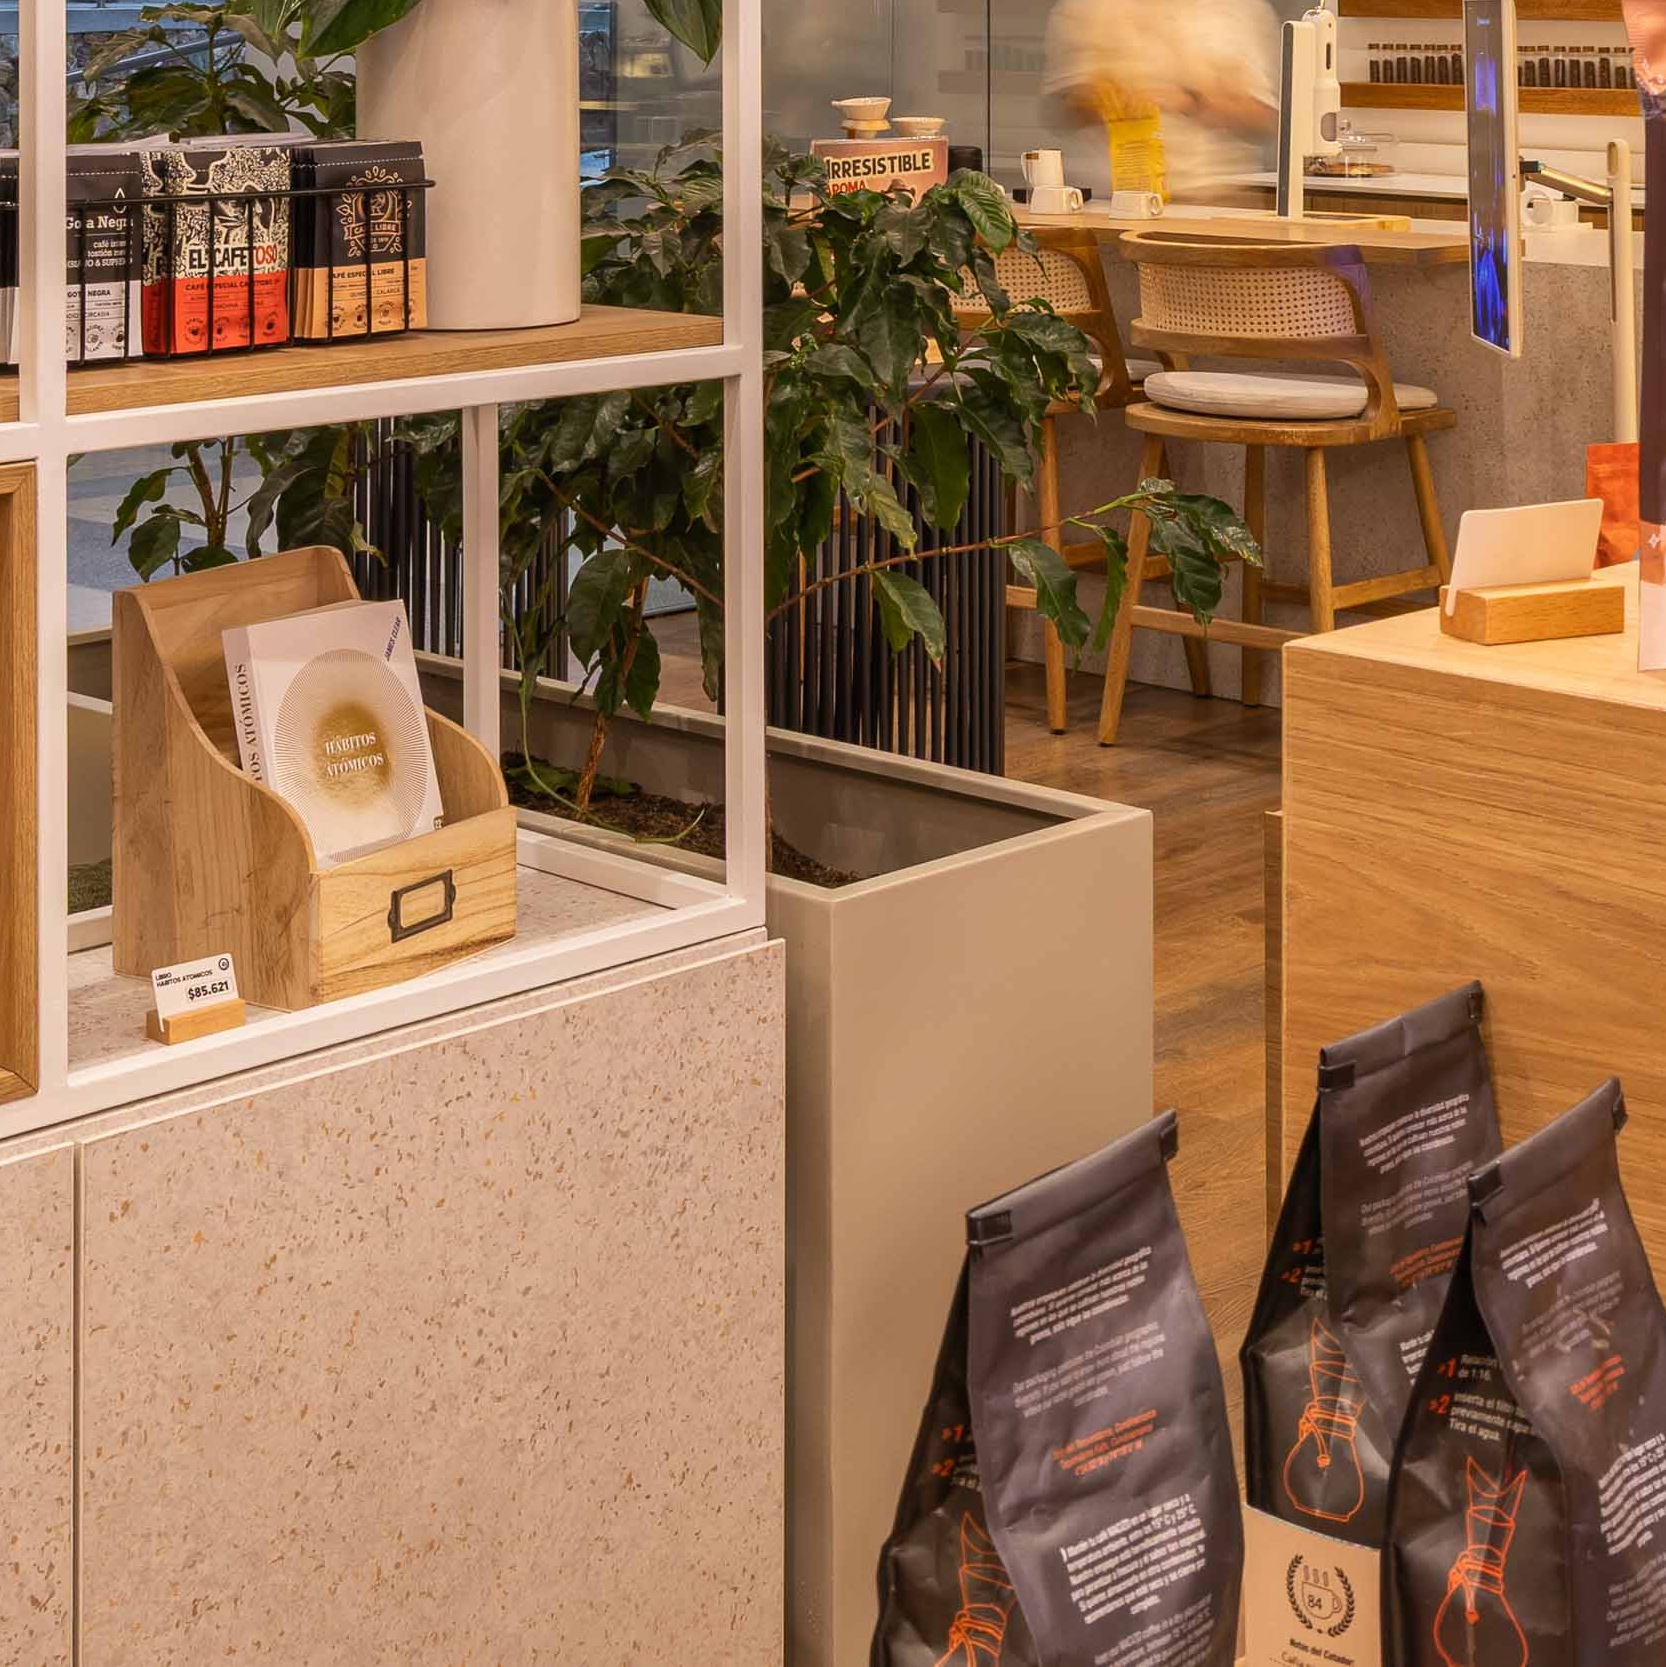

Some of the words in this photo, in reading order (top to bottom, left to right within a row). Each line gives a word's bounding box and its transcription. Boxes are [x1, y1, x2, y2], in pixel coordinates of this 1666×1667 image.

[827, 152, 930, 179] IRRESISTIBLE
[66, 216, 94, 230] Goa
[189, 248, 206, 269] EL
[325, 732, 377, 756] HÁBITOS
[326, 753, 383, 778] ATÓMICOS
[188, 980, 229, 1000] $85.621
[1308, 1595, 1322, 1610] 84
